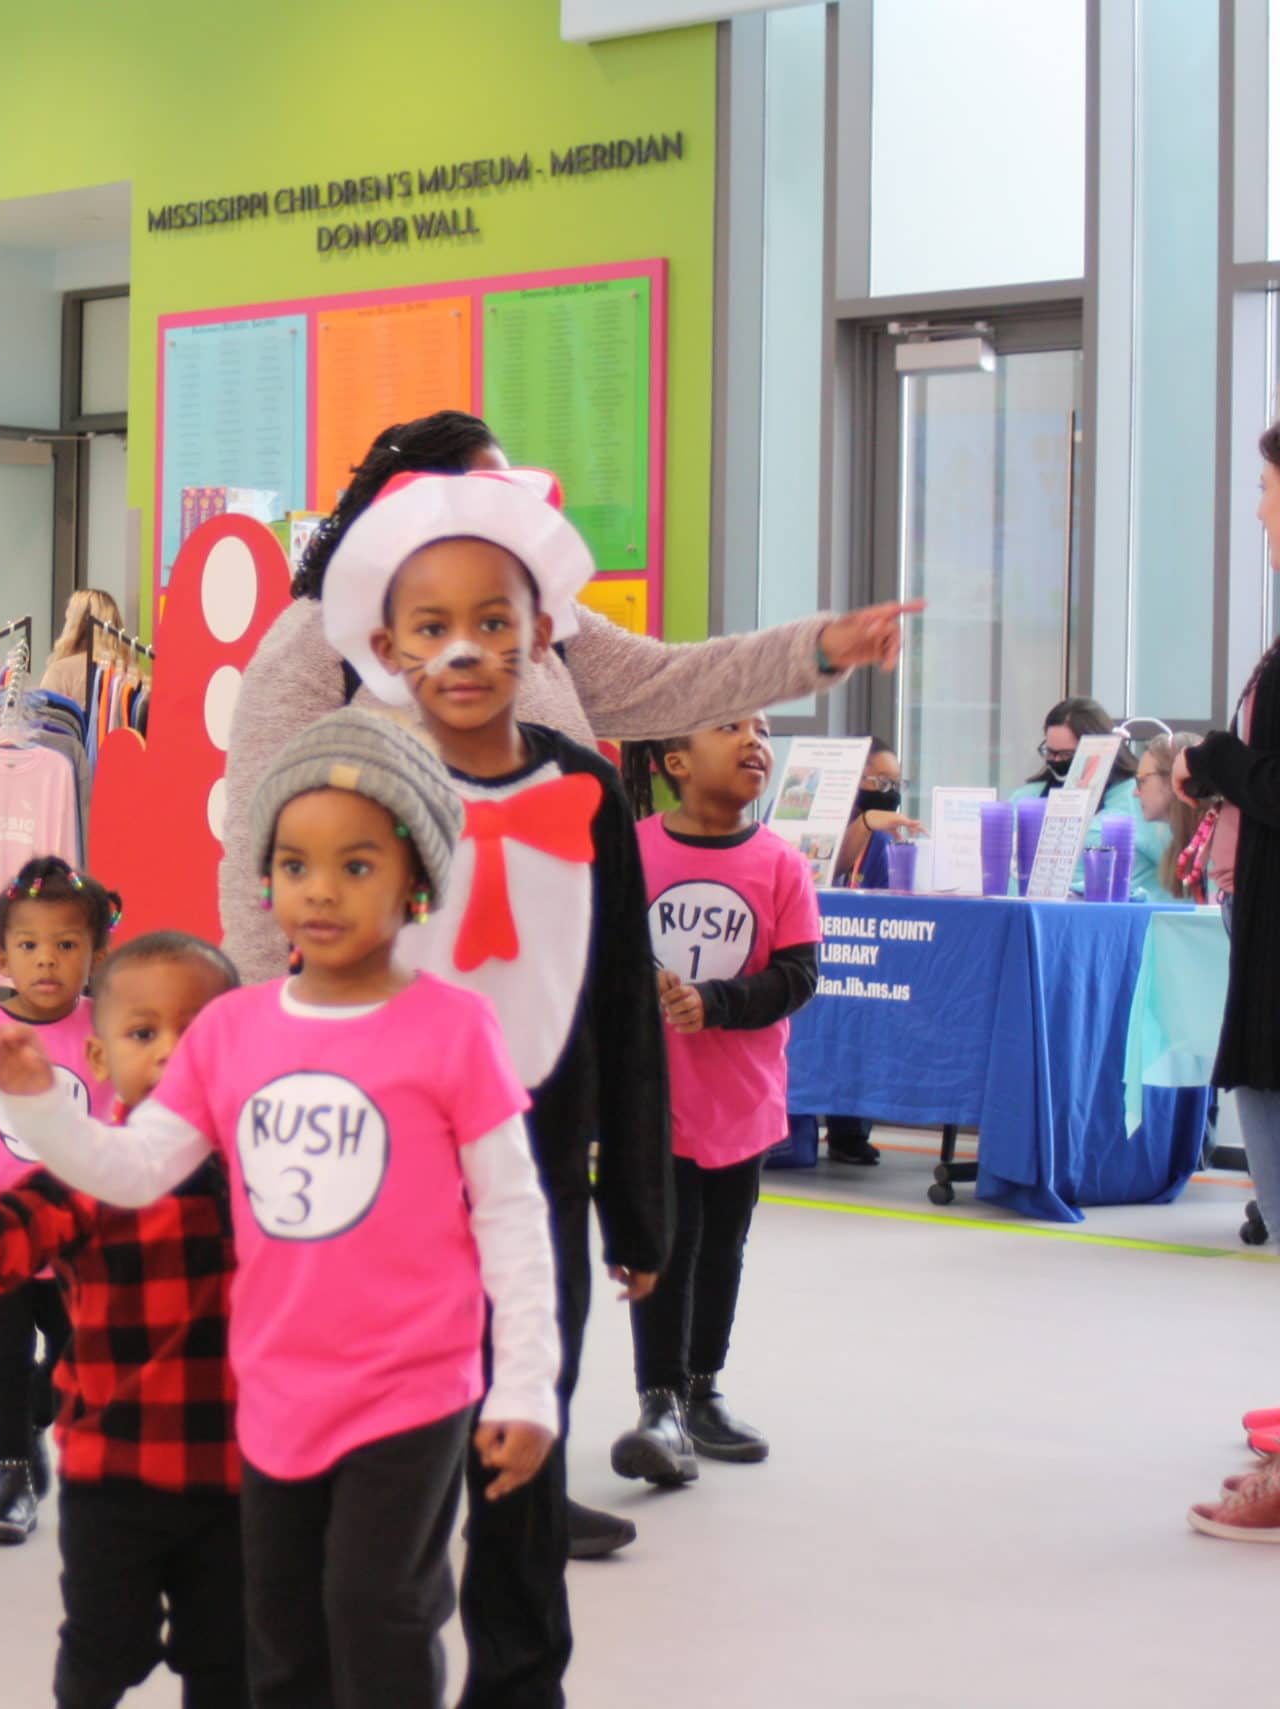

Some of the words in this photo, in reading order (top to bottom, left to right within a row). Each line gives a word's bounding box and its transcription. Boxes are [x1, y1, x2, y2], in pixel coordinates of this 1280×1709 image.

[147, 190, 268, 233] MISSISSIPPI
[274, 170, 412, 214] CHILDREN'S
[418, 152, 530, 195] MUSEUM
[551, 130, 683, 176] MERIDIAN
[317, 216, 408, 252] DONOR
[412, 207, 480, 240] WALL
[658, 901, 747, 942] RUSH
[879, 918, 936, 942] COUNTY
[688, 944, 702, 980] 1
[820, 943, 880, 966] LIBRARY
[251, 1098, 368, 1158] RUSH
[275, 1166, 313, 1226] 3
